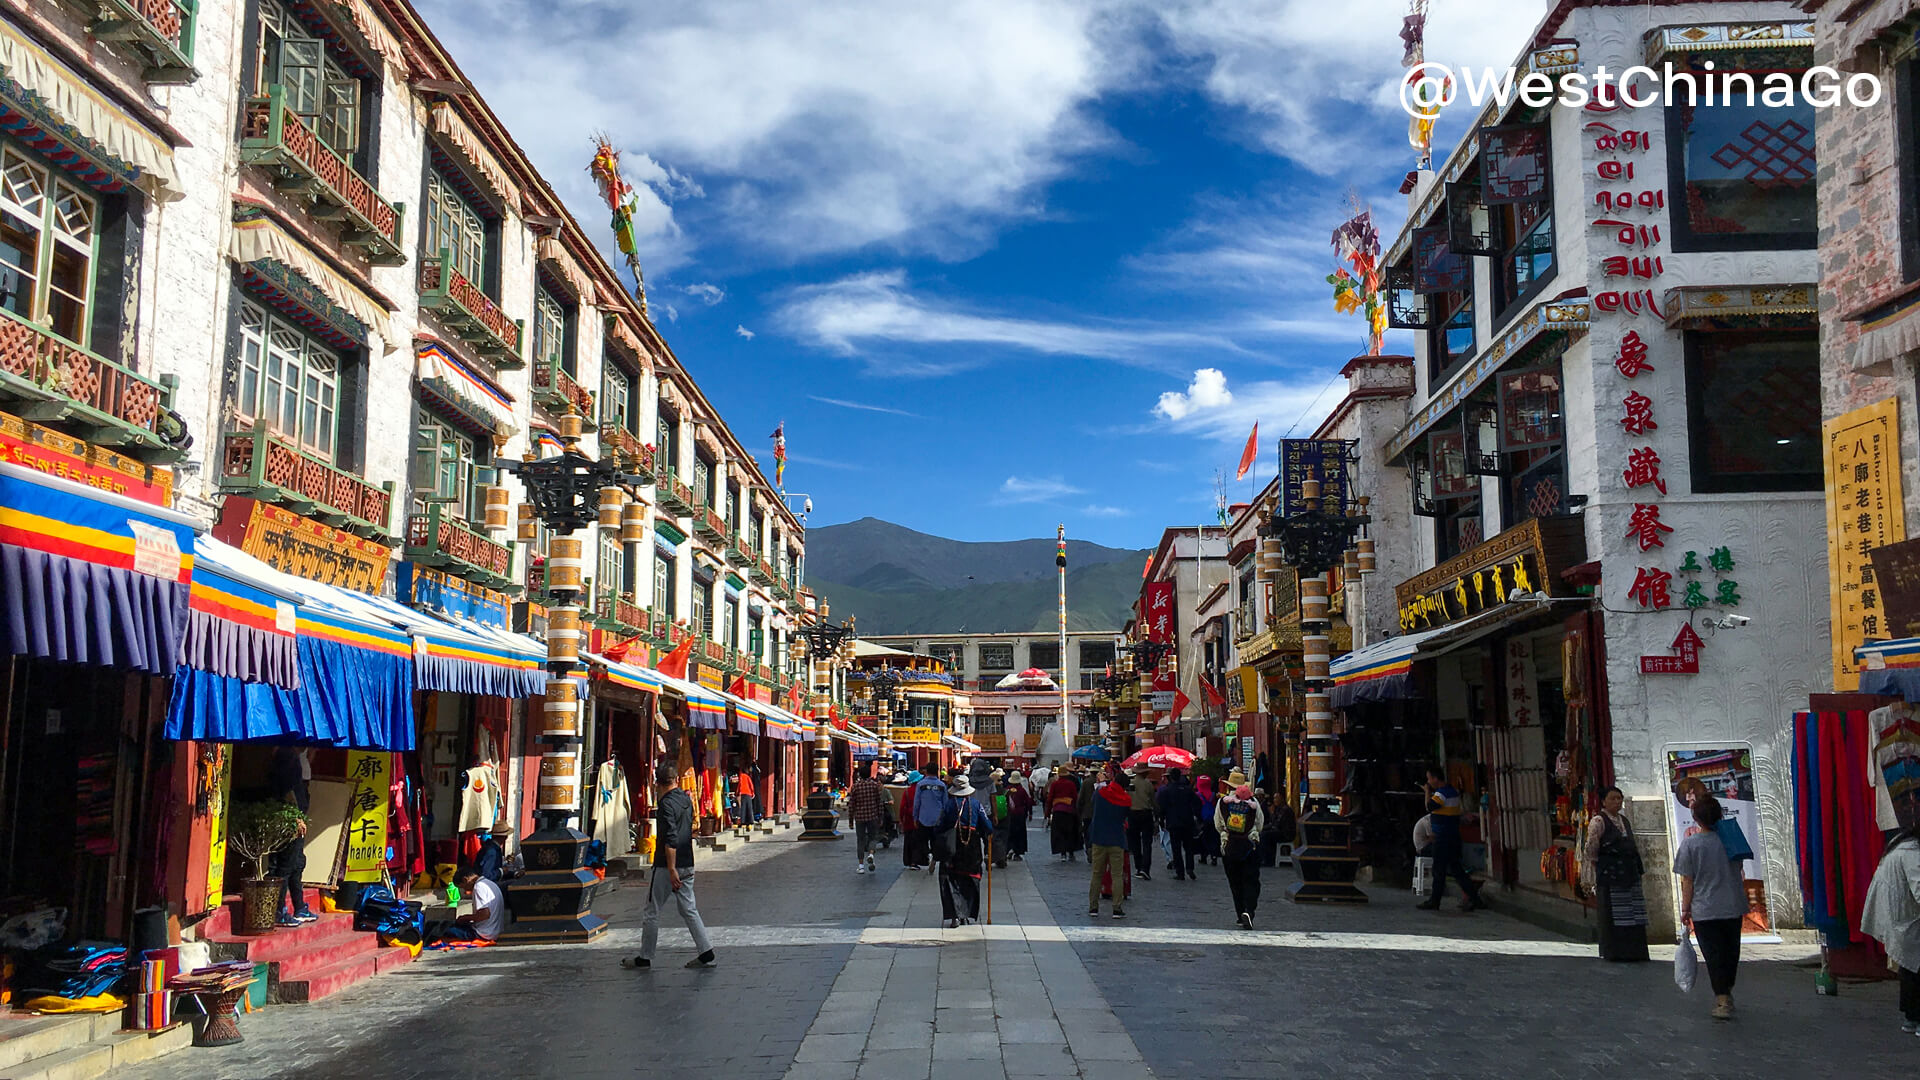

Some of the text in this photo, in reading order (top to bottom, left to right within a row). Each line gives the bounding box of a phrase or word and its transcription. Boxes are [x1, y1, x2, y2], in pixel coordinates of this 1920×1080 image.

[1615, 330, 1675, 610] 象泉藏餐馆
[1872, 434, 1881, 484] Bakhor
[1853, 438, 1878, 635] 八廓老巷丰富餐馆
[1644, 658, 1684, 672] 前行十米
[1682, 630, 1696, 664] 上楼梯
[350, 755, 383, 843] 廓唐卡
